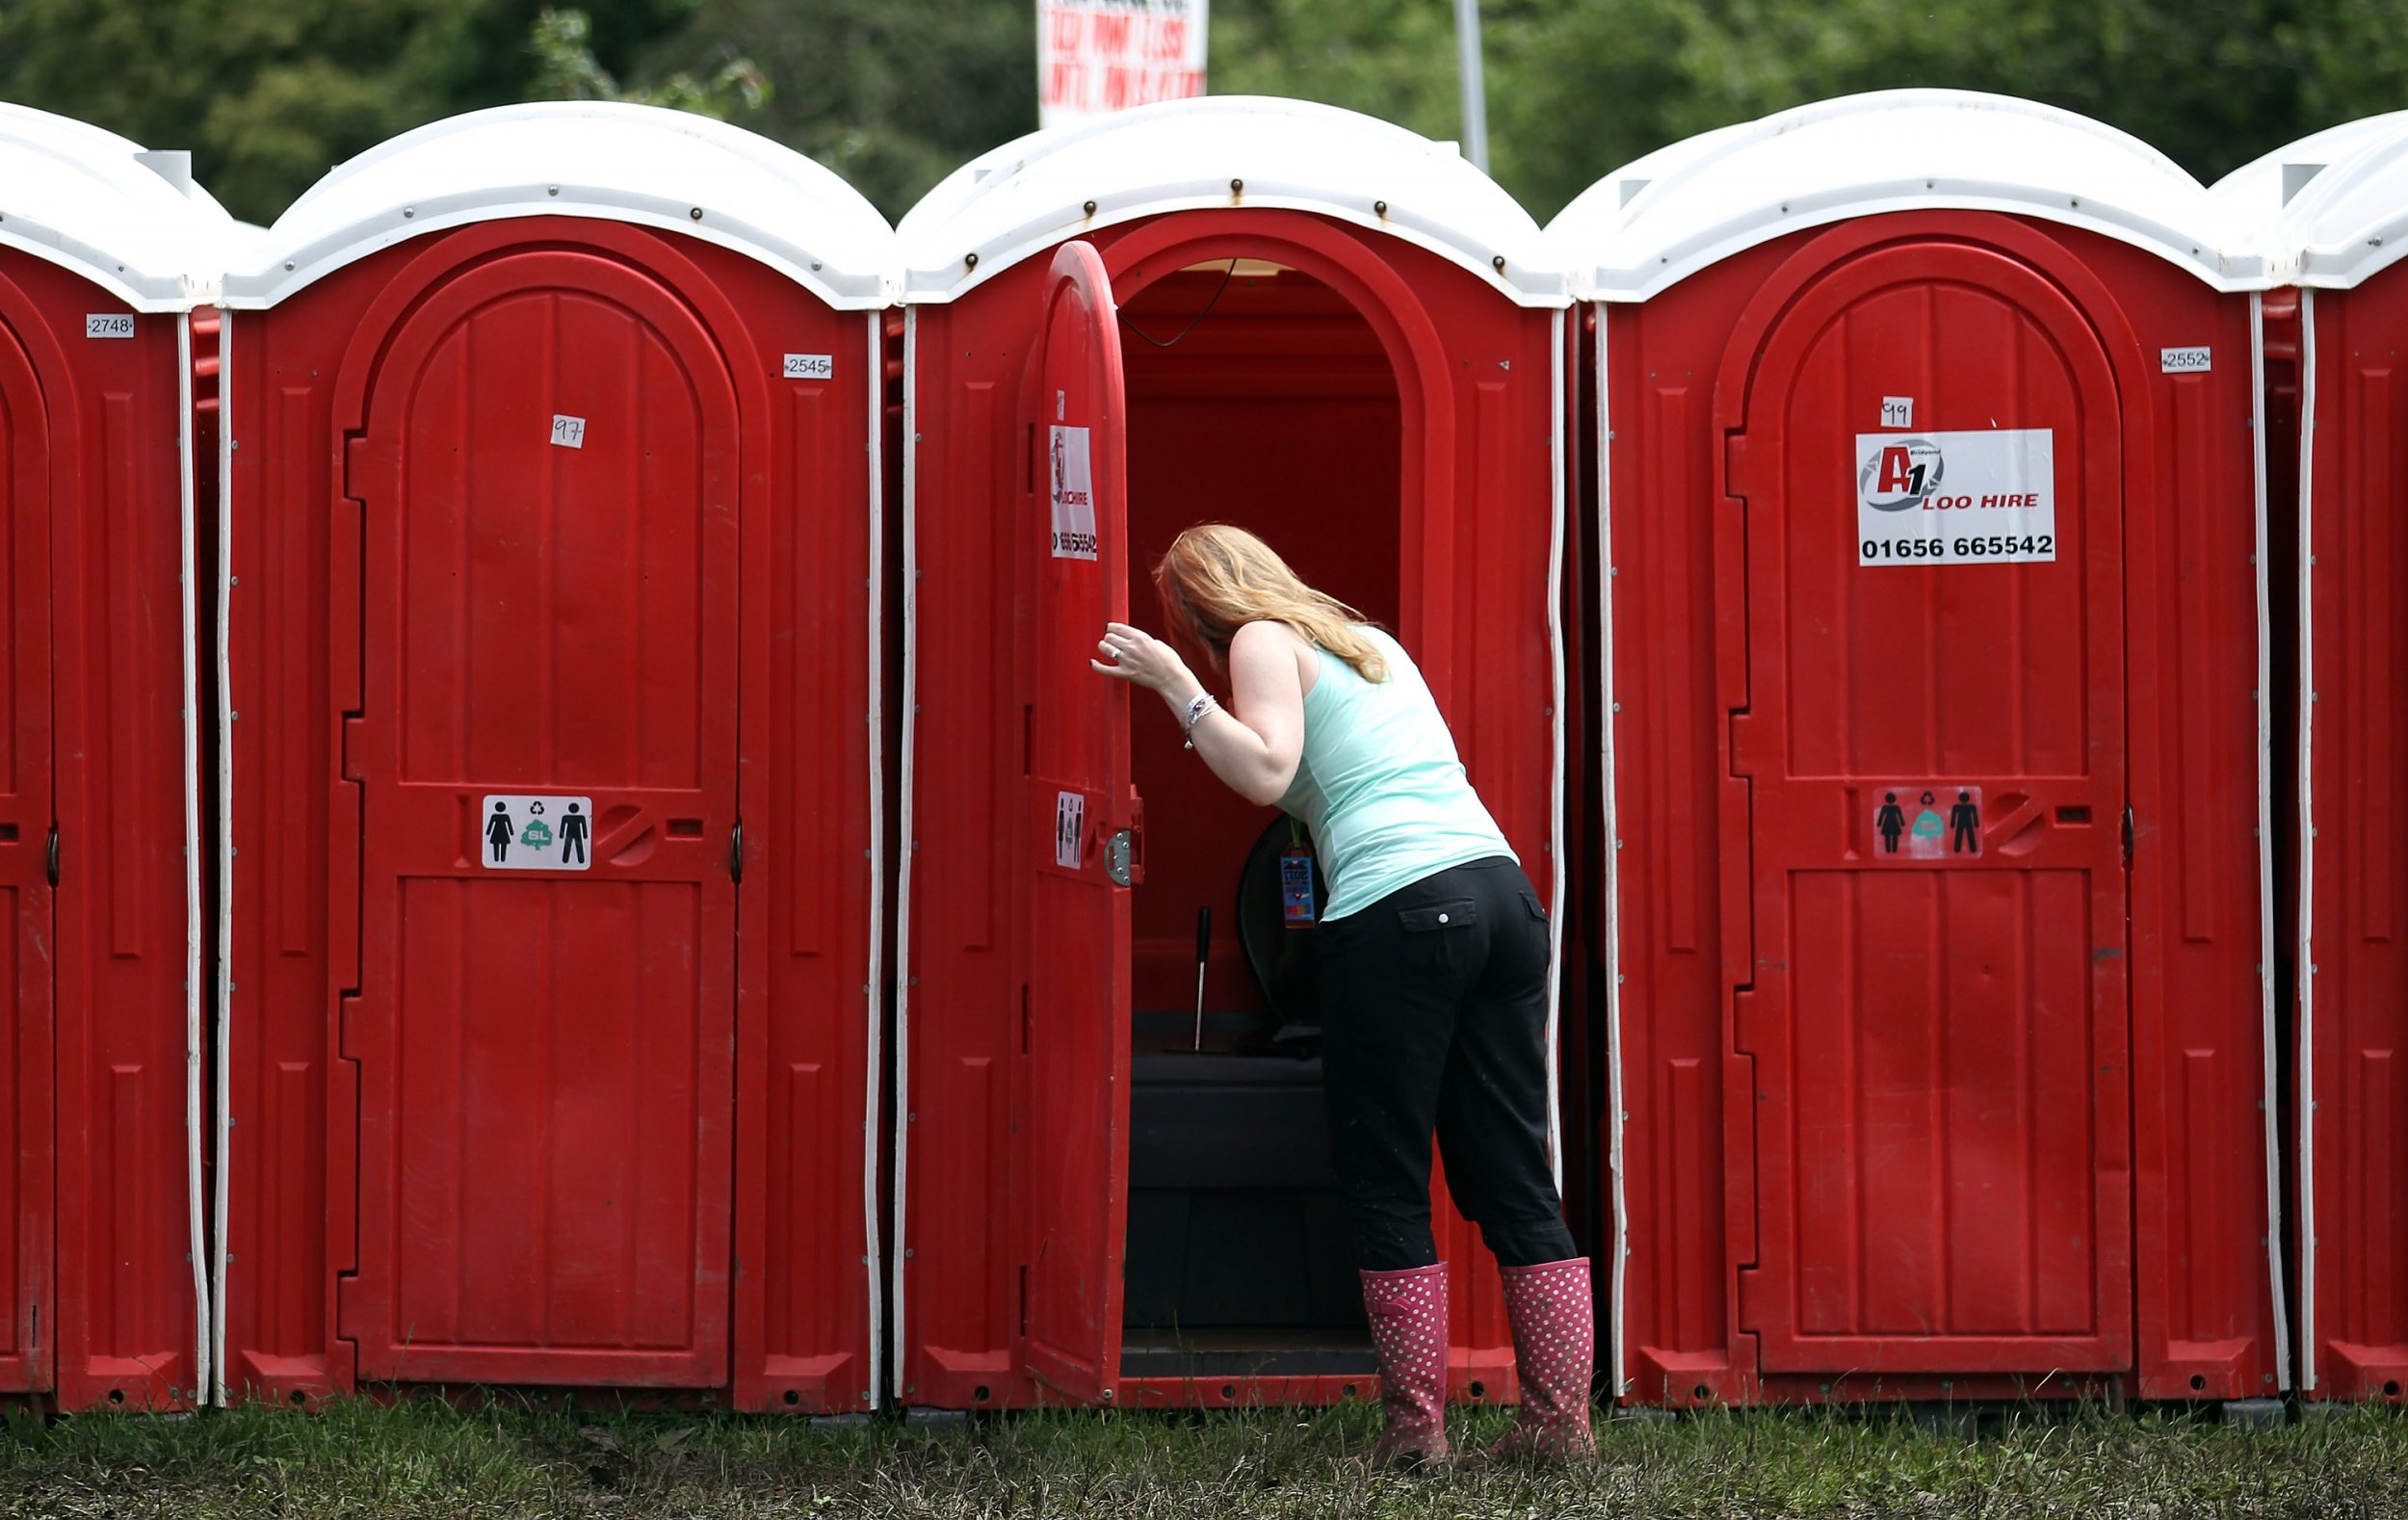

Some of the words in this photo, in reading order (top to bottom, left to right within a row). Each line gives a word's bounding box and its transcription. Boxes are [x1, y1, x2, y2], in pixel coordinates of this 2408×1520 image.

[92, 319, 129, 332] 2748
[789, 359, 826, 373] 2545
[2167, 352, 2205, 367] 2552
[1882, 402, 1907, 425] 99
[555, 419, 583, 441] 97
[1877, 446, 1926, 495] A1
[1923, 495, 1972, 511] LOO
[1980, 493, 2039, 509] HIRE
[1862, 538, 1945, 559] 01656
[1953, 536, 2054, 557] 665542
[528, 830, 549, 840] SL
